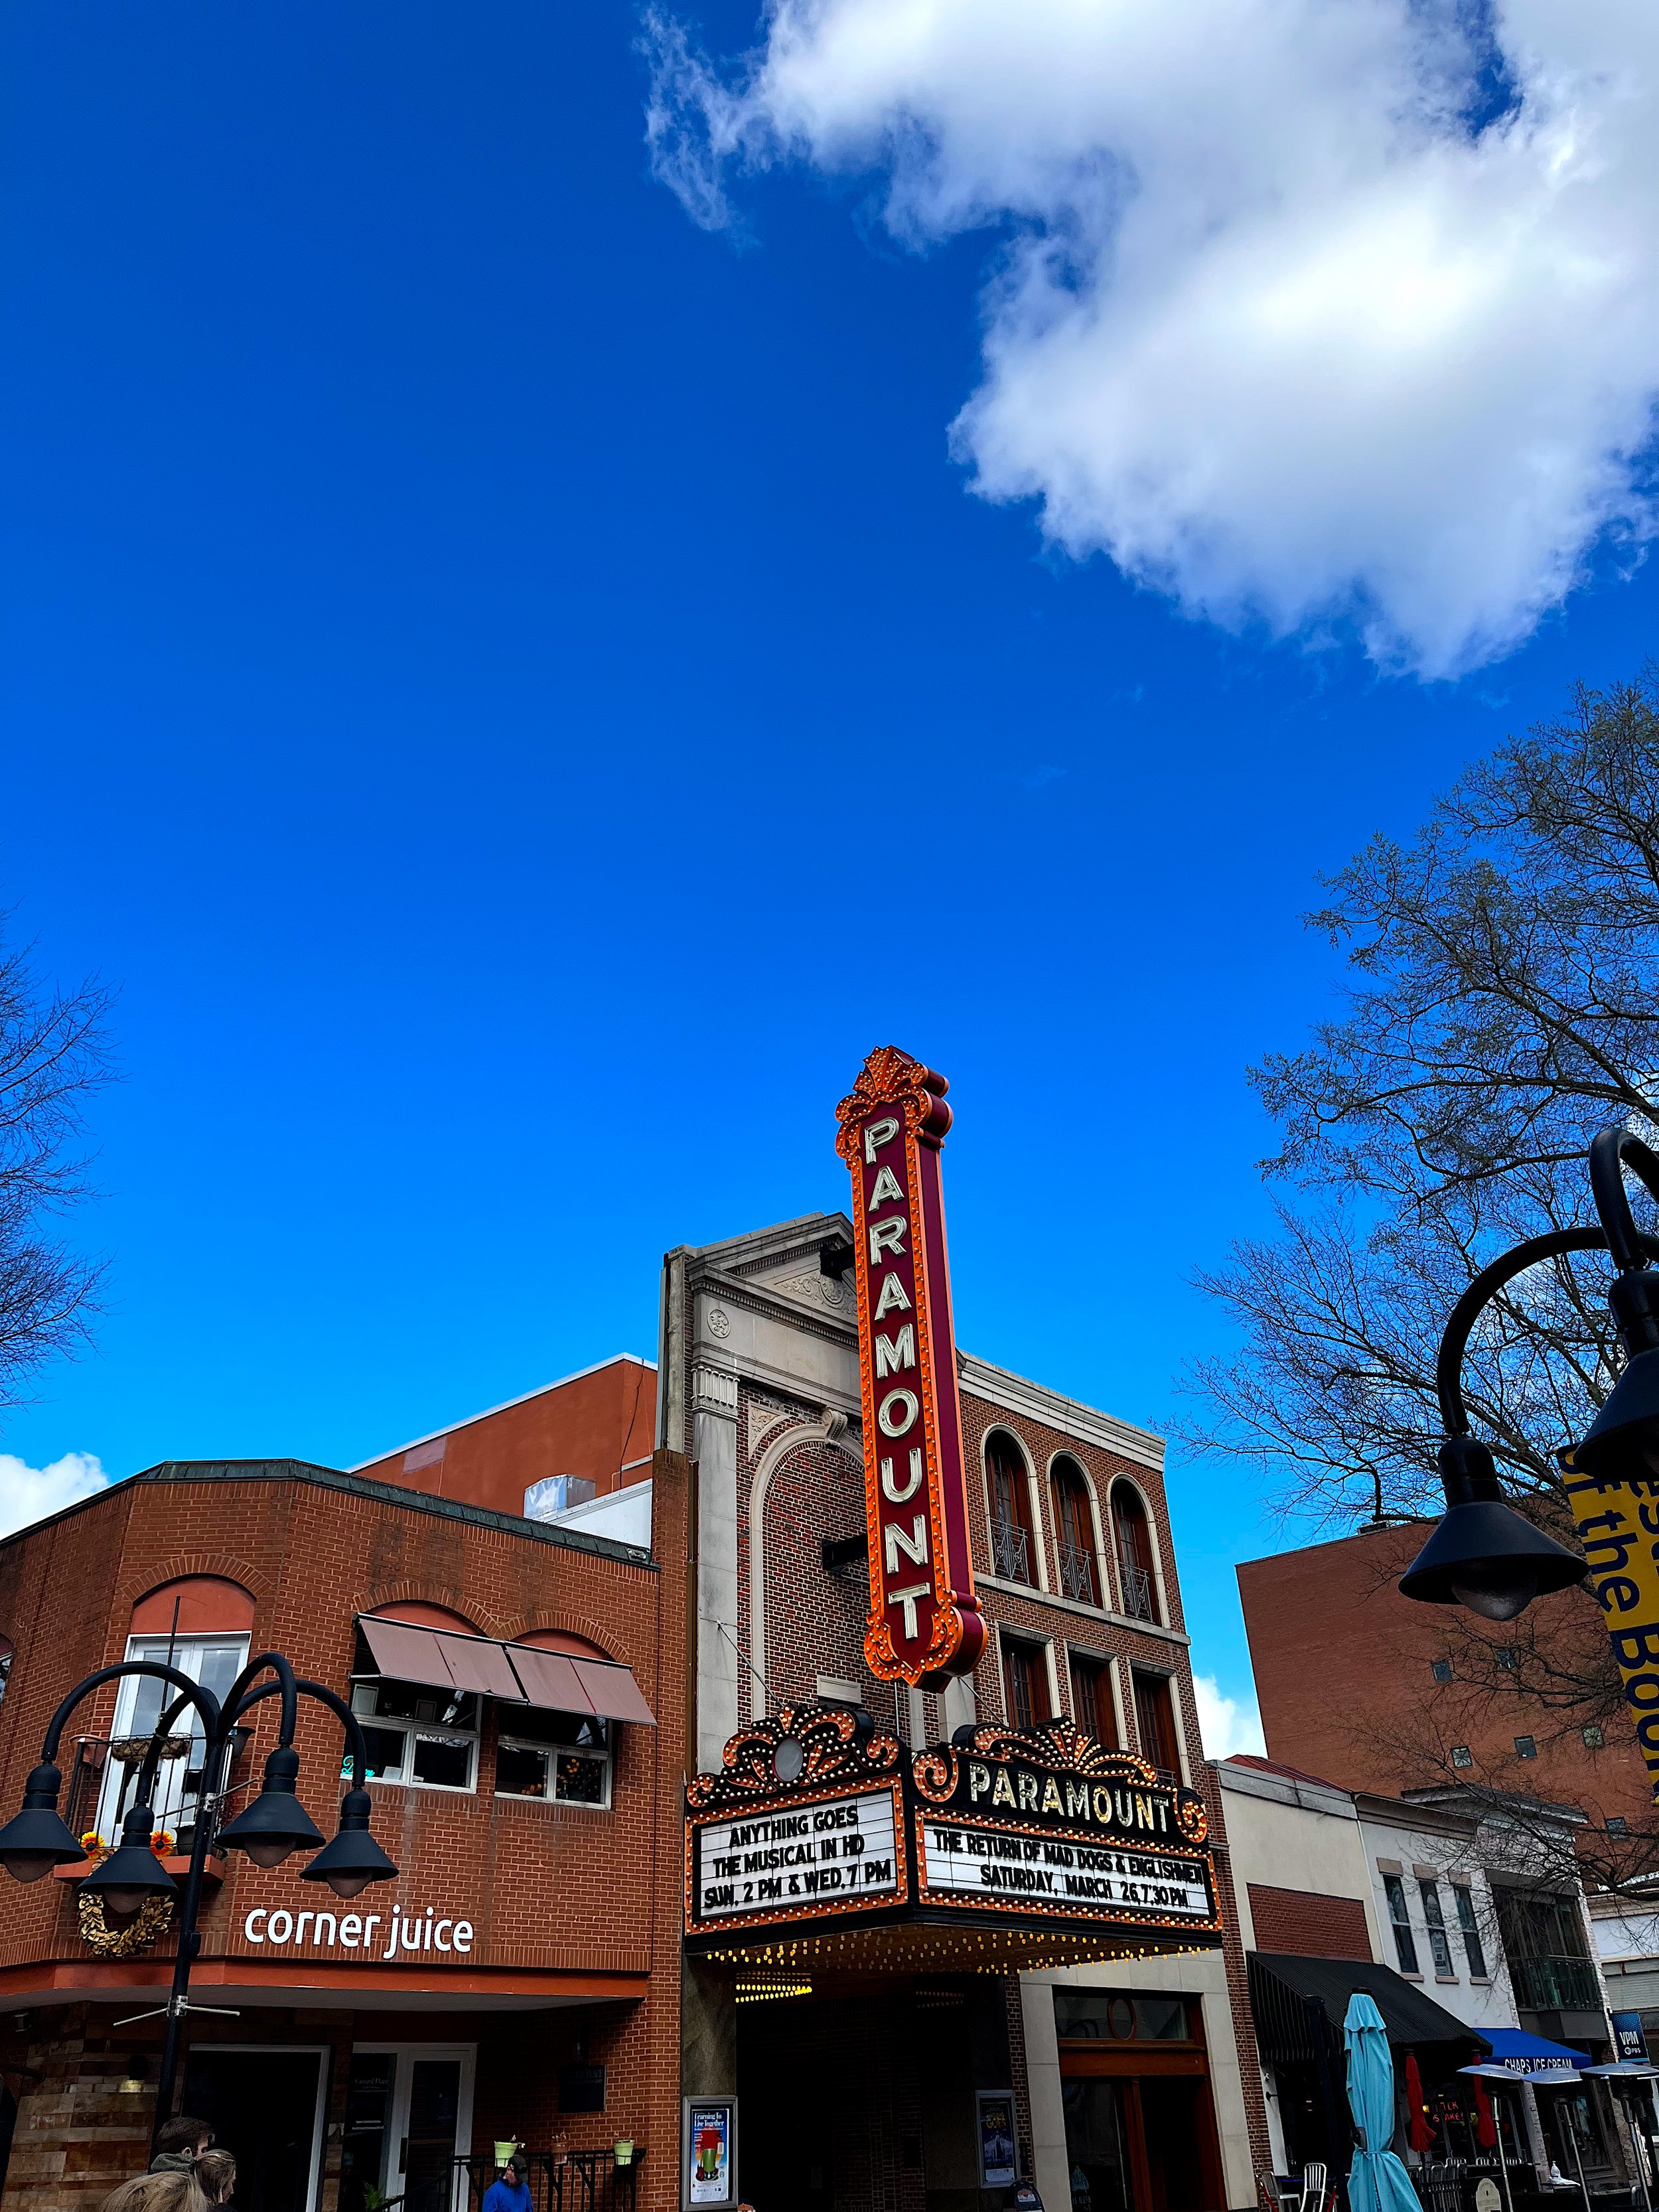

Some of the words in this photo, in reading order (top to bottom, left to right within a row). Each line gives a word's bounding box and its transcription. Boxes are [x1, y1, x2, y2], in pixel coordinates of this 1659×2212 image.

[863, 1116, 932, 1642] PARAMOUNT
[1578, 1509, 1640, 1613] the
[1609, 1621, 1659, 1804] Boo
[969, 1761, 1169, 1832] PARAMOUNT
[729, 1814, 808, 1848] ANYTHING
[813, 1805, 859, 1832] GOES
[713, 1855, 741, 1878] THE
[744, 1842, 817, 1873] MUSICAL
[821, 1838, 837, 1859] IN
[843, 1834, 865, 1858] HD
[934, 1828, 964, 1852] THE
[966, 1833, 1022, 1860] RETURN
[1023, 1840, 1041, 1861] OF
[1044, 1843, 1074, 1867] MAD
[1076, 1848, 1114, 1873] DOGS
[1115, 1853, 1126, 1874] &
[1129, 1856, 1204, 1885] ENGLISHMEN
[704, 1885, 739, 1909] SUN.
[743, 1881, 754, 1903] 2
[758, 1877, 782, 1901] PM
[788, 1874, 801, 1895] &
[804, 1867, 846, 1895] WED.
[846, 1863, 858, 1887] 7
[865, 1858, 891, 1884] PM
[980, 1864, 1058, 1897] SATURDAY,
[1065, 1874, 1114, 1900] MARCH
[244, 1907, 382, 1948] corner
[383, 1903, 474, 1960] juice
[1619, 2031, 1639, 2045] VPM
[1504, 2058, 1532, 2074] CHAPS
[1533, 2058, 1546, 2072] ICE
[1433, 2112, 1464, 2122] SAKE!
